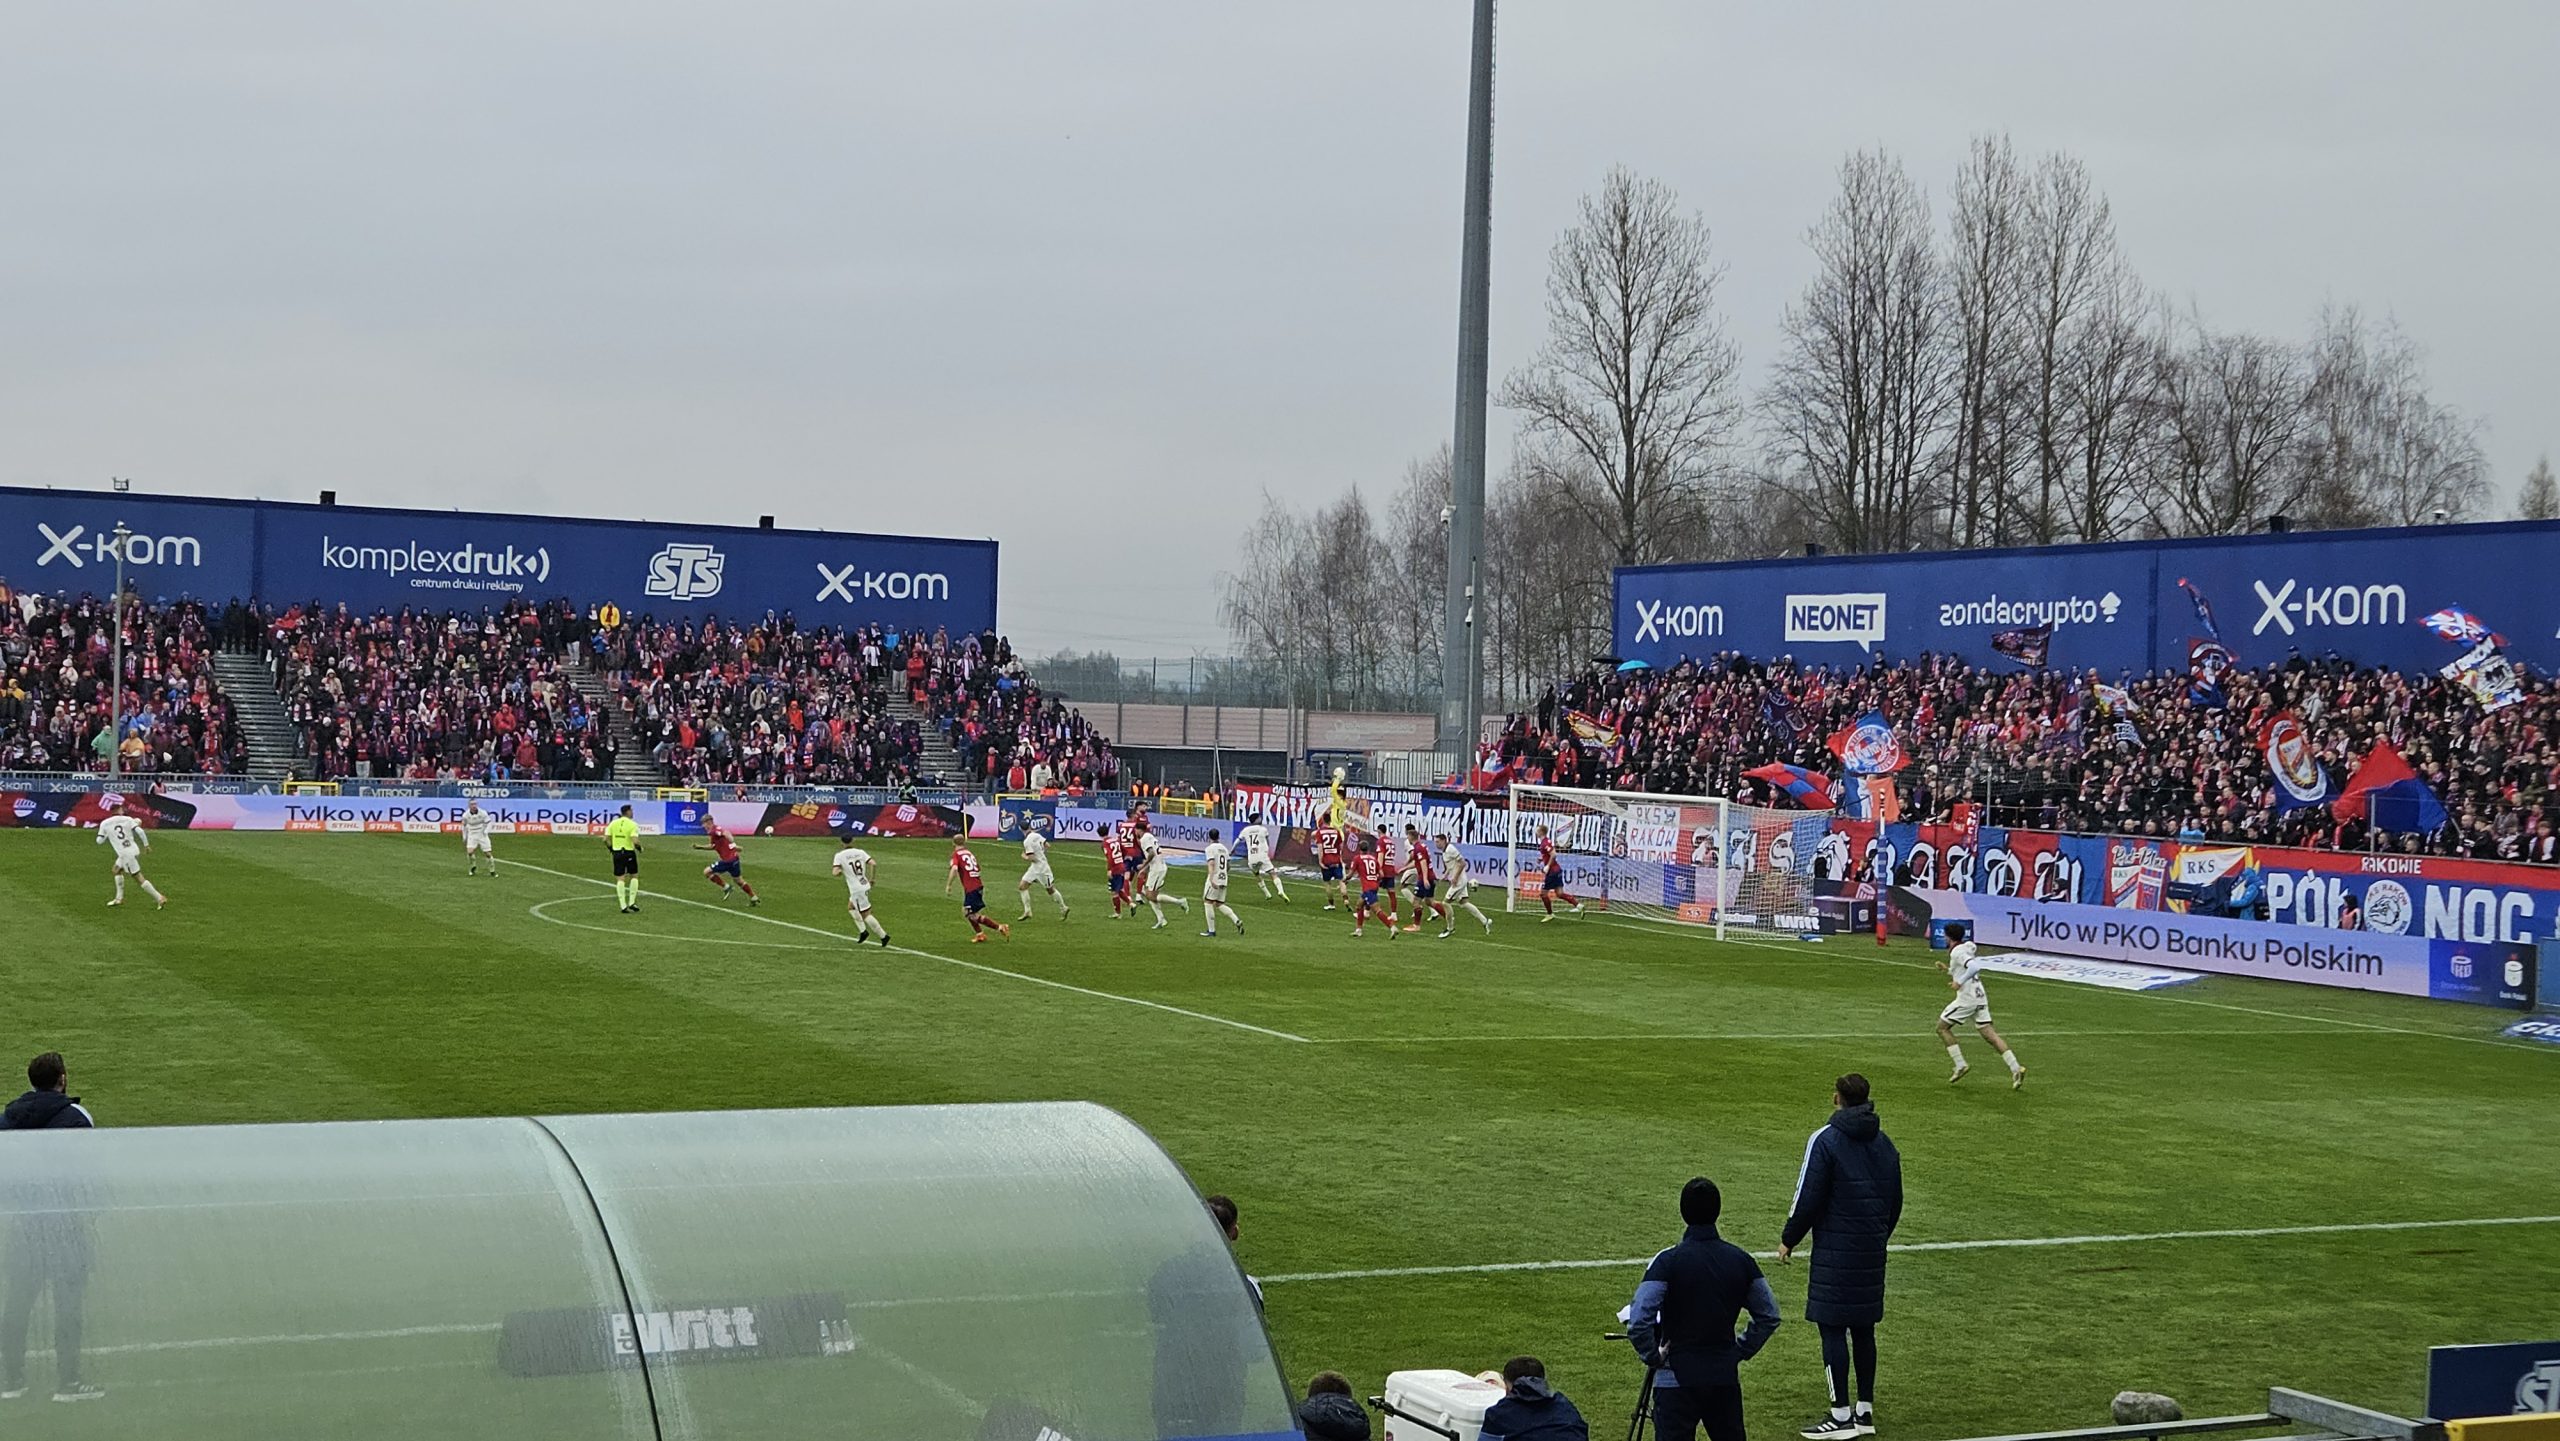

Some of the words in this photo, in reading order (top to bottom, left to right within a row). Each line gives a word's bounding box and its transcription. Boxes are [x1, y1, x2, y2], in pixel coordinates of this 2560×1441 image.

[323, 535, 524, 577] komplexdruk
[644, 543, 725, 601] STS
[410, 578, 451, 588] centrum
[452, 579, 481, 590] druku
[487, 581, 523, 593] reklamy
[1791, 603, 1879, 631] NEONET
[361, 810, 382, 822] w
[389, 807, 443, 823] PKO
[114, 825, 125, 839] 3
[1120, 828, 1134, 842] 24
[1248, 834, 1260, 846] 14
[1322, 835, 1338, 848] 27
[849, 860, 863, 876] 18
[1219, 855, 1226, 870] 9
[1363, 860, 1376, 875] 19
[1474, 860, 1486, 874] w
[2187, 859, 2215, 874] RKS
[2361, 856, 2423, 874] RAKOWIE
[2425, 884, 2535, 945] NOC
[2006, 911, 2070, 941] Tylko
[2076, 924, 2097, 943] w
[2103, 922, 2160, 951] PKO
[2167, 928, 2257, 963] Banku
[2265, 939, 2383, 976] Polskim
